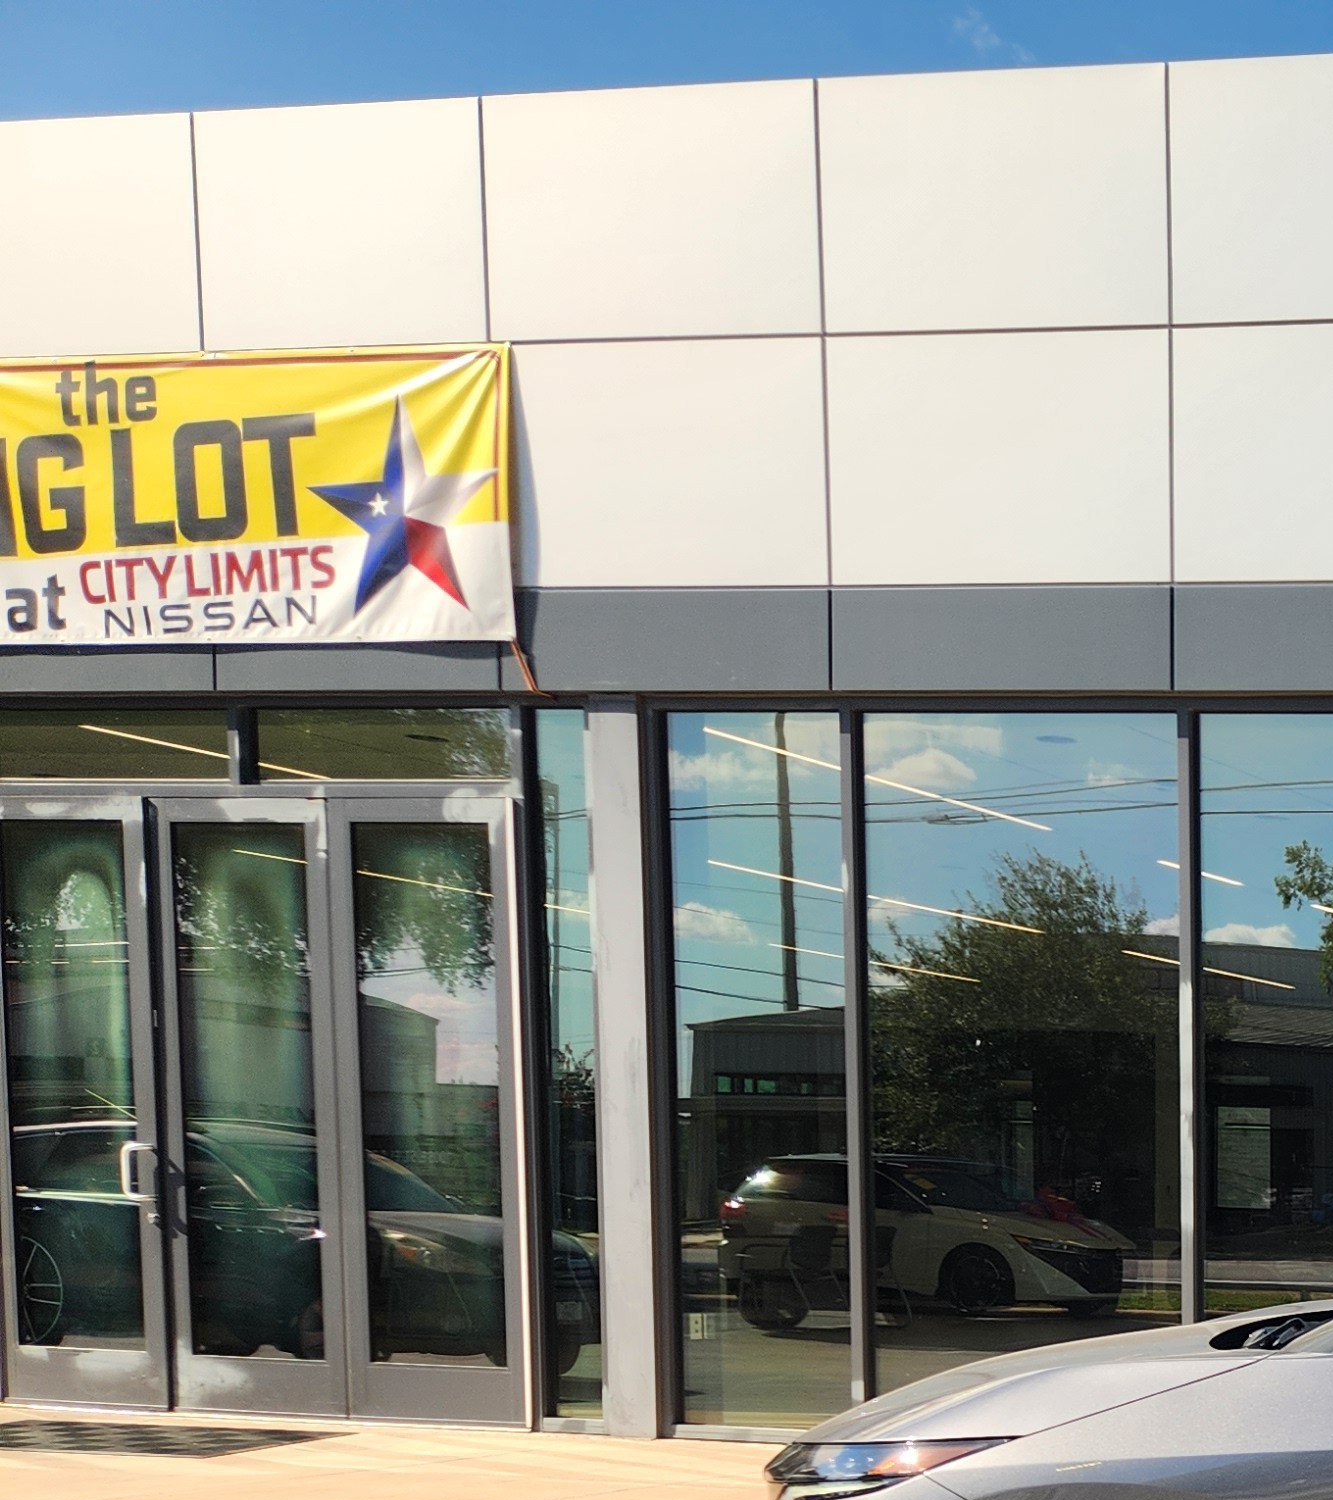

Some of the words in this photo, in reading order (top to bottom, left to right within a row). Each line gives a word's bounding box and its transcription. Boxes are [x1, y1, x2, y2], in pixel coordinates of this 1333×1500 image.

[55, 360, 157, 427] the
[110, 413, 316, 548] LOT
[6, 574, 66, 633] at
[79, 554, 178, 605] CITY
[185, 545, 336, 597] LIMITS
[104, 595, 317, 639] NISSAN
